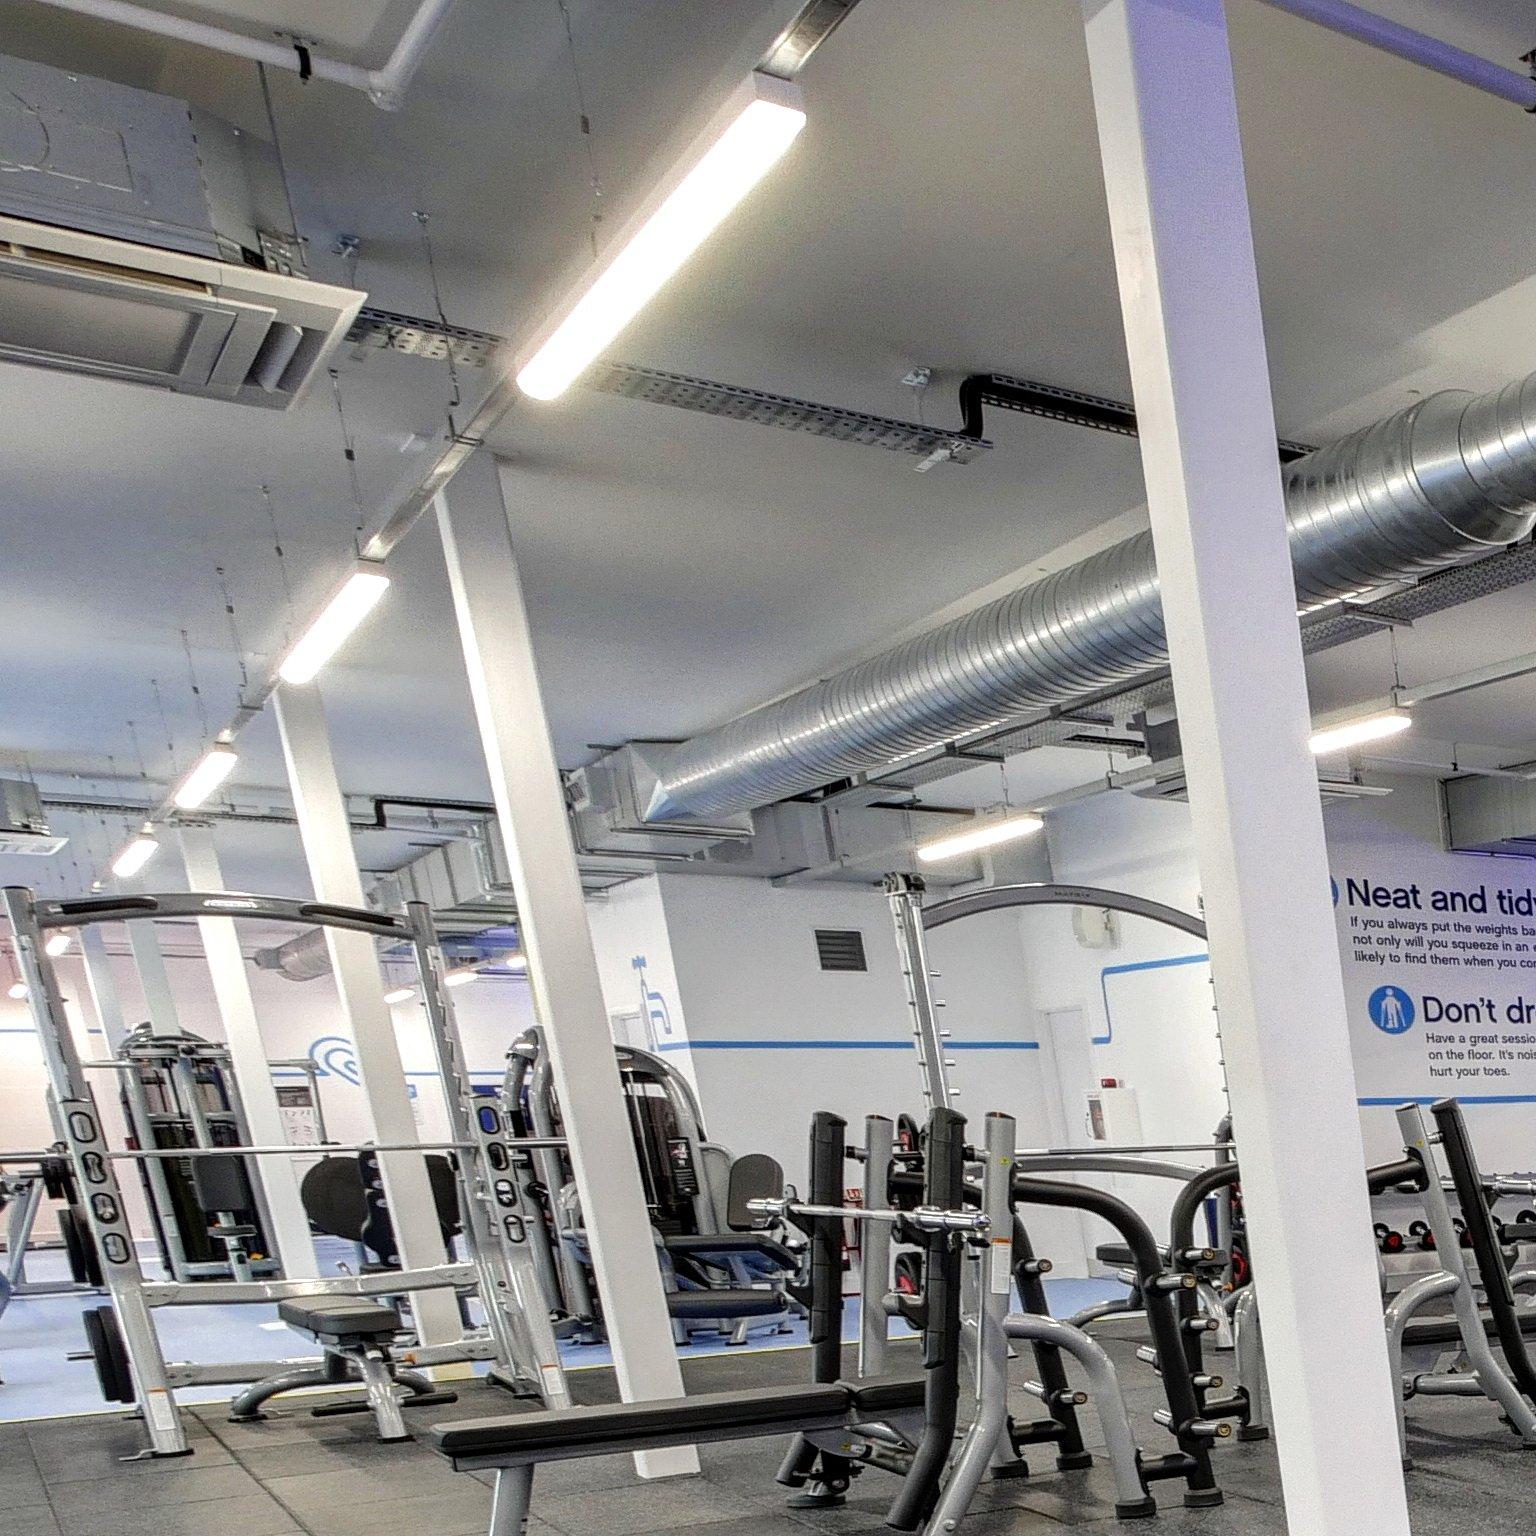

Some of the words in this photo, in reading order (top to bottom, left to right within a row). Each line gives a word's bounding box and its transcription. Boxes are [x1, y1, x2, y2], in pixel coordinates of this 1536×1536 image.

[1346, 878, 1422, 910] Neat
[1431, 885, 1487, 914] and
[1350, 916, 1358, 927] If
[1360, 919, 1384, 931] you
[1385, 918, 1428, 934] always
[1431, 921, 1452, 934] put
[1453, 922, 1472, 933] the
[1475, 923, 1518, 938] weights
[1352, 934, 1374, 946] not
[1376, 934, 1401, 949] only
[1404, 935, 1424, 948] will
[1426, 939, 1448, 951] you
[1452, 940, 1500, 952] squeeze
[1502, 940, 1512, 952] in
[1515, 944, 1529, 952] an
[1354, 950, 1386, 966] likely
[1389, 952, 1401, 963] to
[1405, 952, 1427, 964] find
[1430, 953, 1460, 966] them
[1463, 956, 1494, 967] when
[1497, 959, 1517, 970] you
[1422, 996, 1497, 1024] Don't
[1426, 1033, 1455, 1044] Have
[1458, 1035, 1466, 1043] a
[1469, 1034, 1498, 1047] great
[1428, 1052, 1443, 1060] on
[1446, 1048, 1464, 1060] the
[1430, 1065, 1453, 1077] hurt
[1455, 1068, 1481, 1079] your
